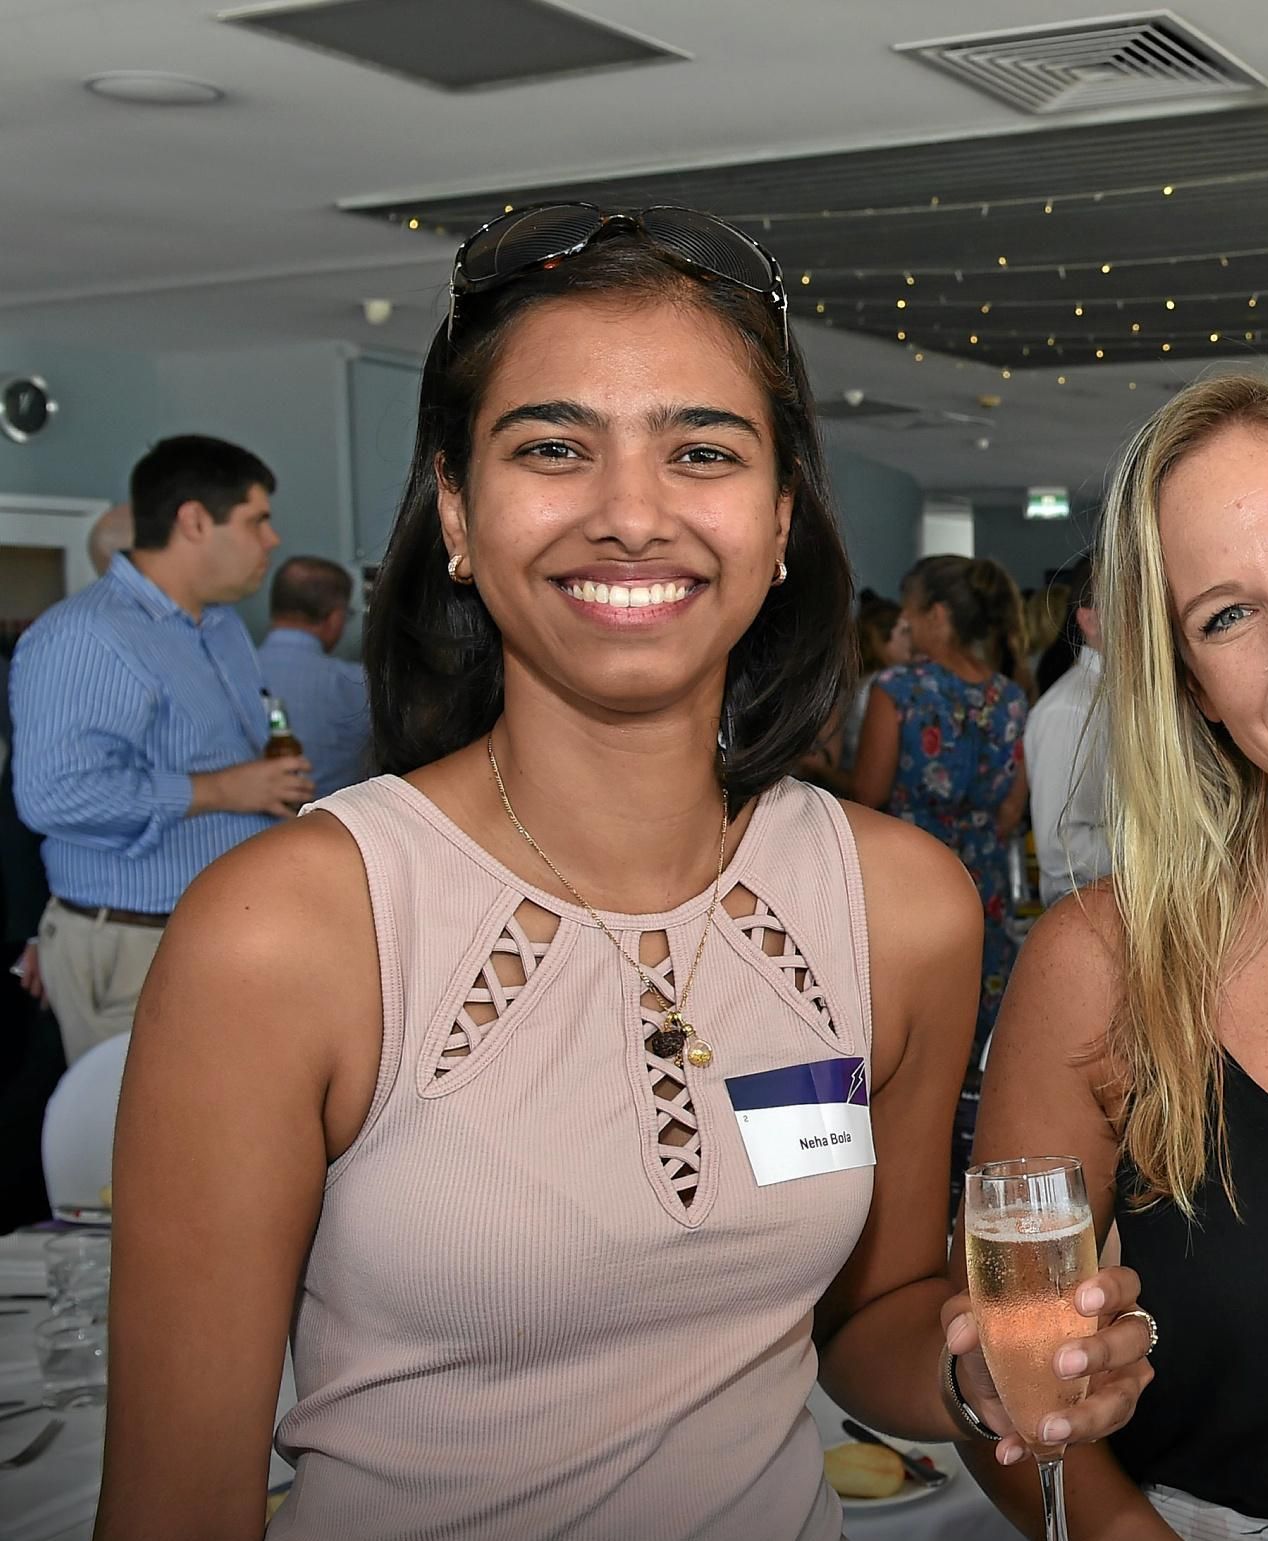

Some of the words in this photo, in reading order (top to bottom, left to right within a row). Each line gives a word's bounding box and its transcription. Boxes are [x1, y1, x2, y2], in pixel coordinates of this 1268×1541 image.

[743, 1115, 749, 1123] 2
[799, 1135, 829, 1150] Neha
[830, 1131, 852, 1145] Bola
